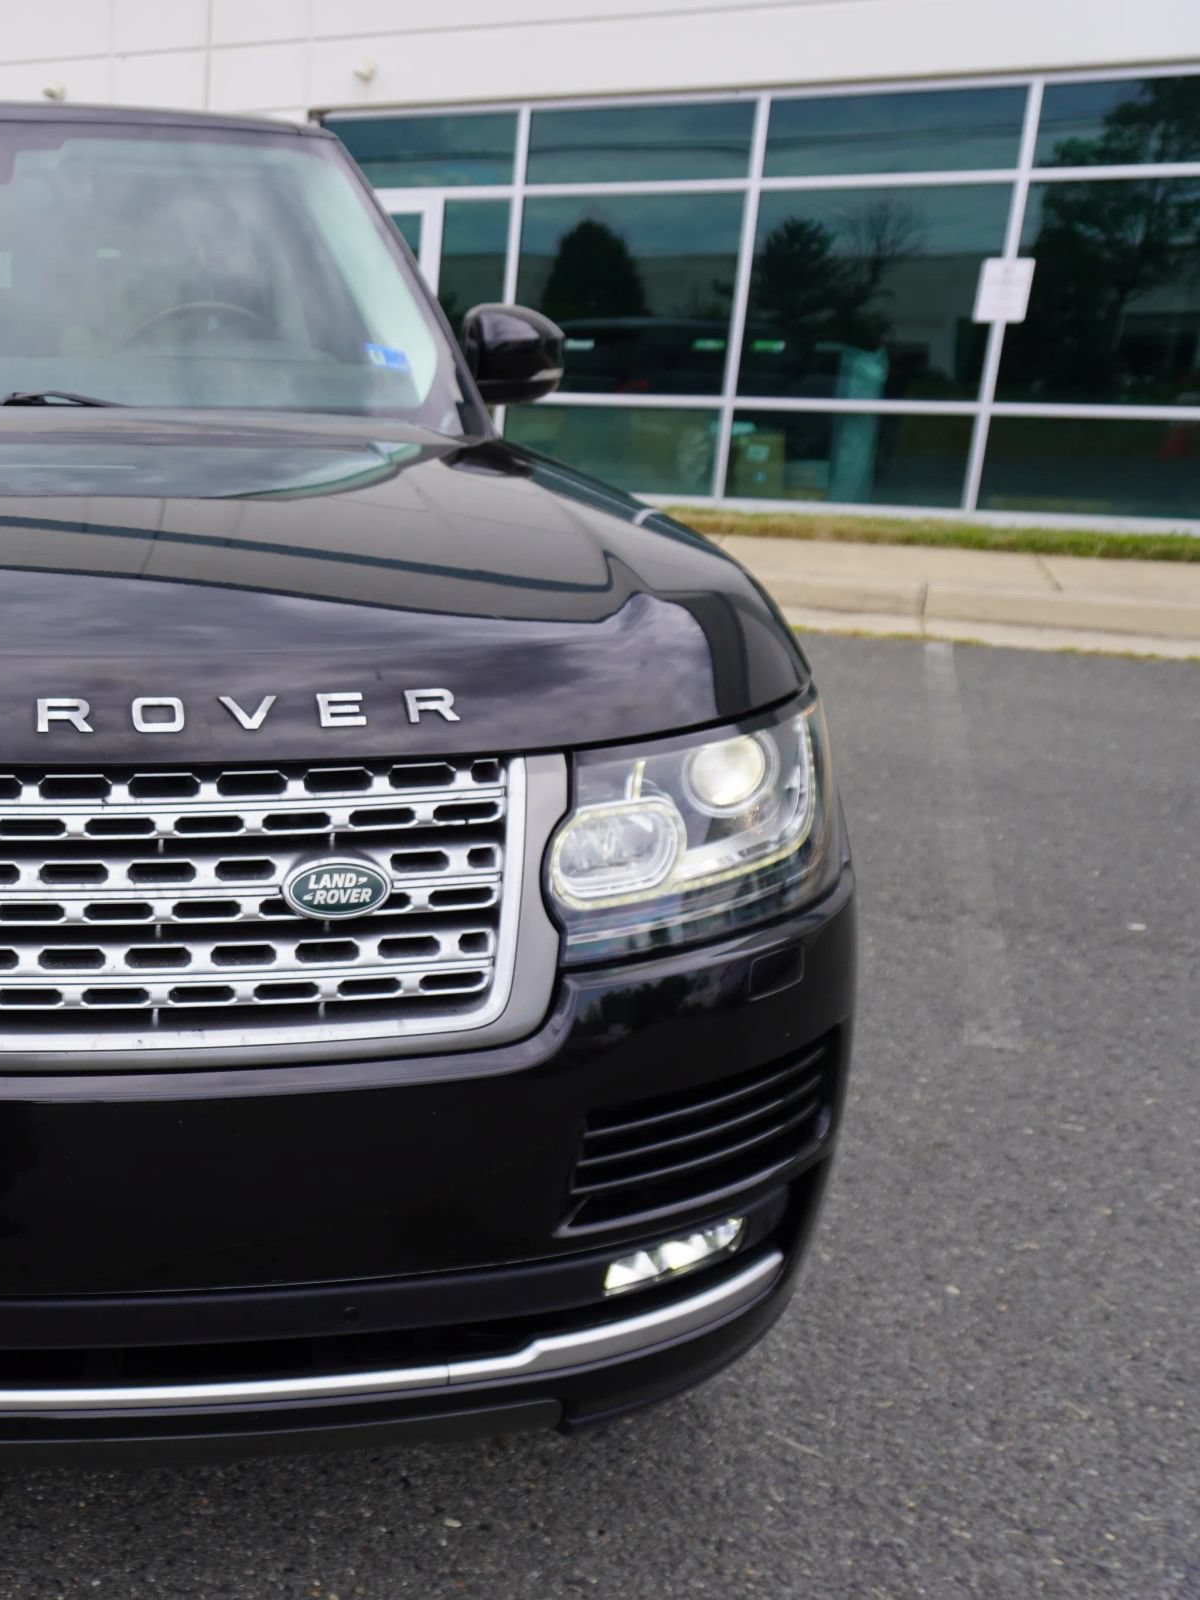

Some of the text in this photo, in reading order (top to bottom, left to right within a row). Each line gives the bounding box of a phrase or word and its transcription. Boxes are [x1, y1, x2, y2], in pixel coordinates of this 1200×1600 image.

[36, 687, 461, 733] ROVER
[308, 872, 357, 889] LAND
[313, 887, 373, 905] ROVER
